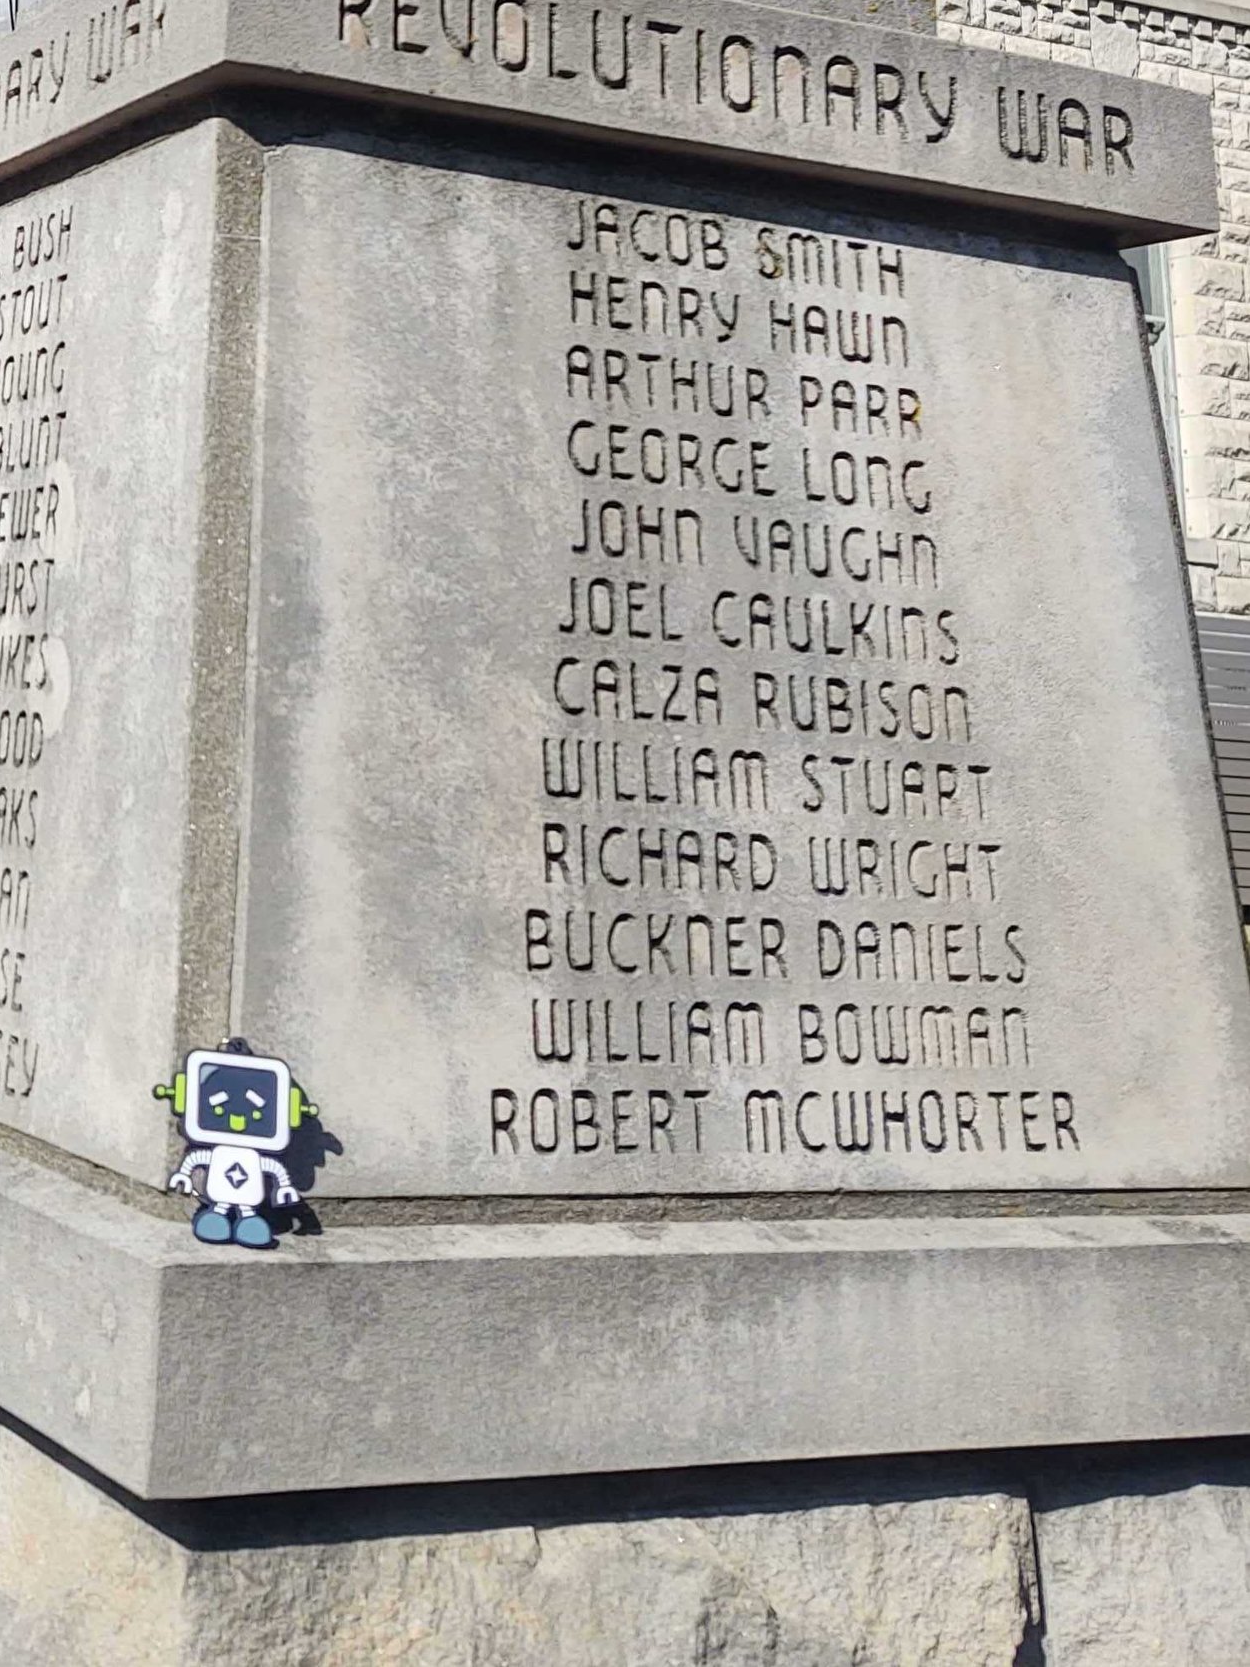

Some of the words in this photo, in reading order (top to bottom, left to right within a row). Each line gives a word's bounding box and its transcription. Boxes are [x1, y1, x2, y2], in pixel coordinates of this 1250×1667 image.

[999, 84, 1135, 176] WAR
[11, 205, 74, 274] BUSH
[566, 198, 728, 271] JACOB
[758, 227, 905, 298] SMITH
[571, 271, 740, 343] HENRY
[769, 297, 909, 366] HAWN
[567, 345, 768, 421] ARTHUR
[800, 375, 924, 438] PARR
[568, 419, 776, 499] GEORGE
[803, 447, 932, 514] LONG
[571, 499, 704, 567] JOHN
[734, 514, 940, 589] VAUGHN
[558, 577, 682, 643] JOEL
[710, 591, 963, 667] CAULKINS
[553, 656, 723, 725] CALZA
[754, 672, 972, 743] RUBISON
[541, 737, 769, 810] WILLIAM
[802, 754, 991, 822] STUART
[543, 823, 778, 893] RICHARD
[808, 835, 1003, 901] WRIGHT
[526, 908, 788, 982] BUCKNER
[817, 919, 1027, 986] DANIELS
[531, 997, 765, 1067] WILLIAM
[798, 1002, 1029, 1067] BOWMAN
[490, 1087, 710, 1156] ROBERT
[744, 1089, 1081, 1154] MCWHORTER
